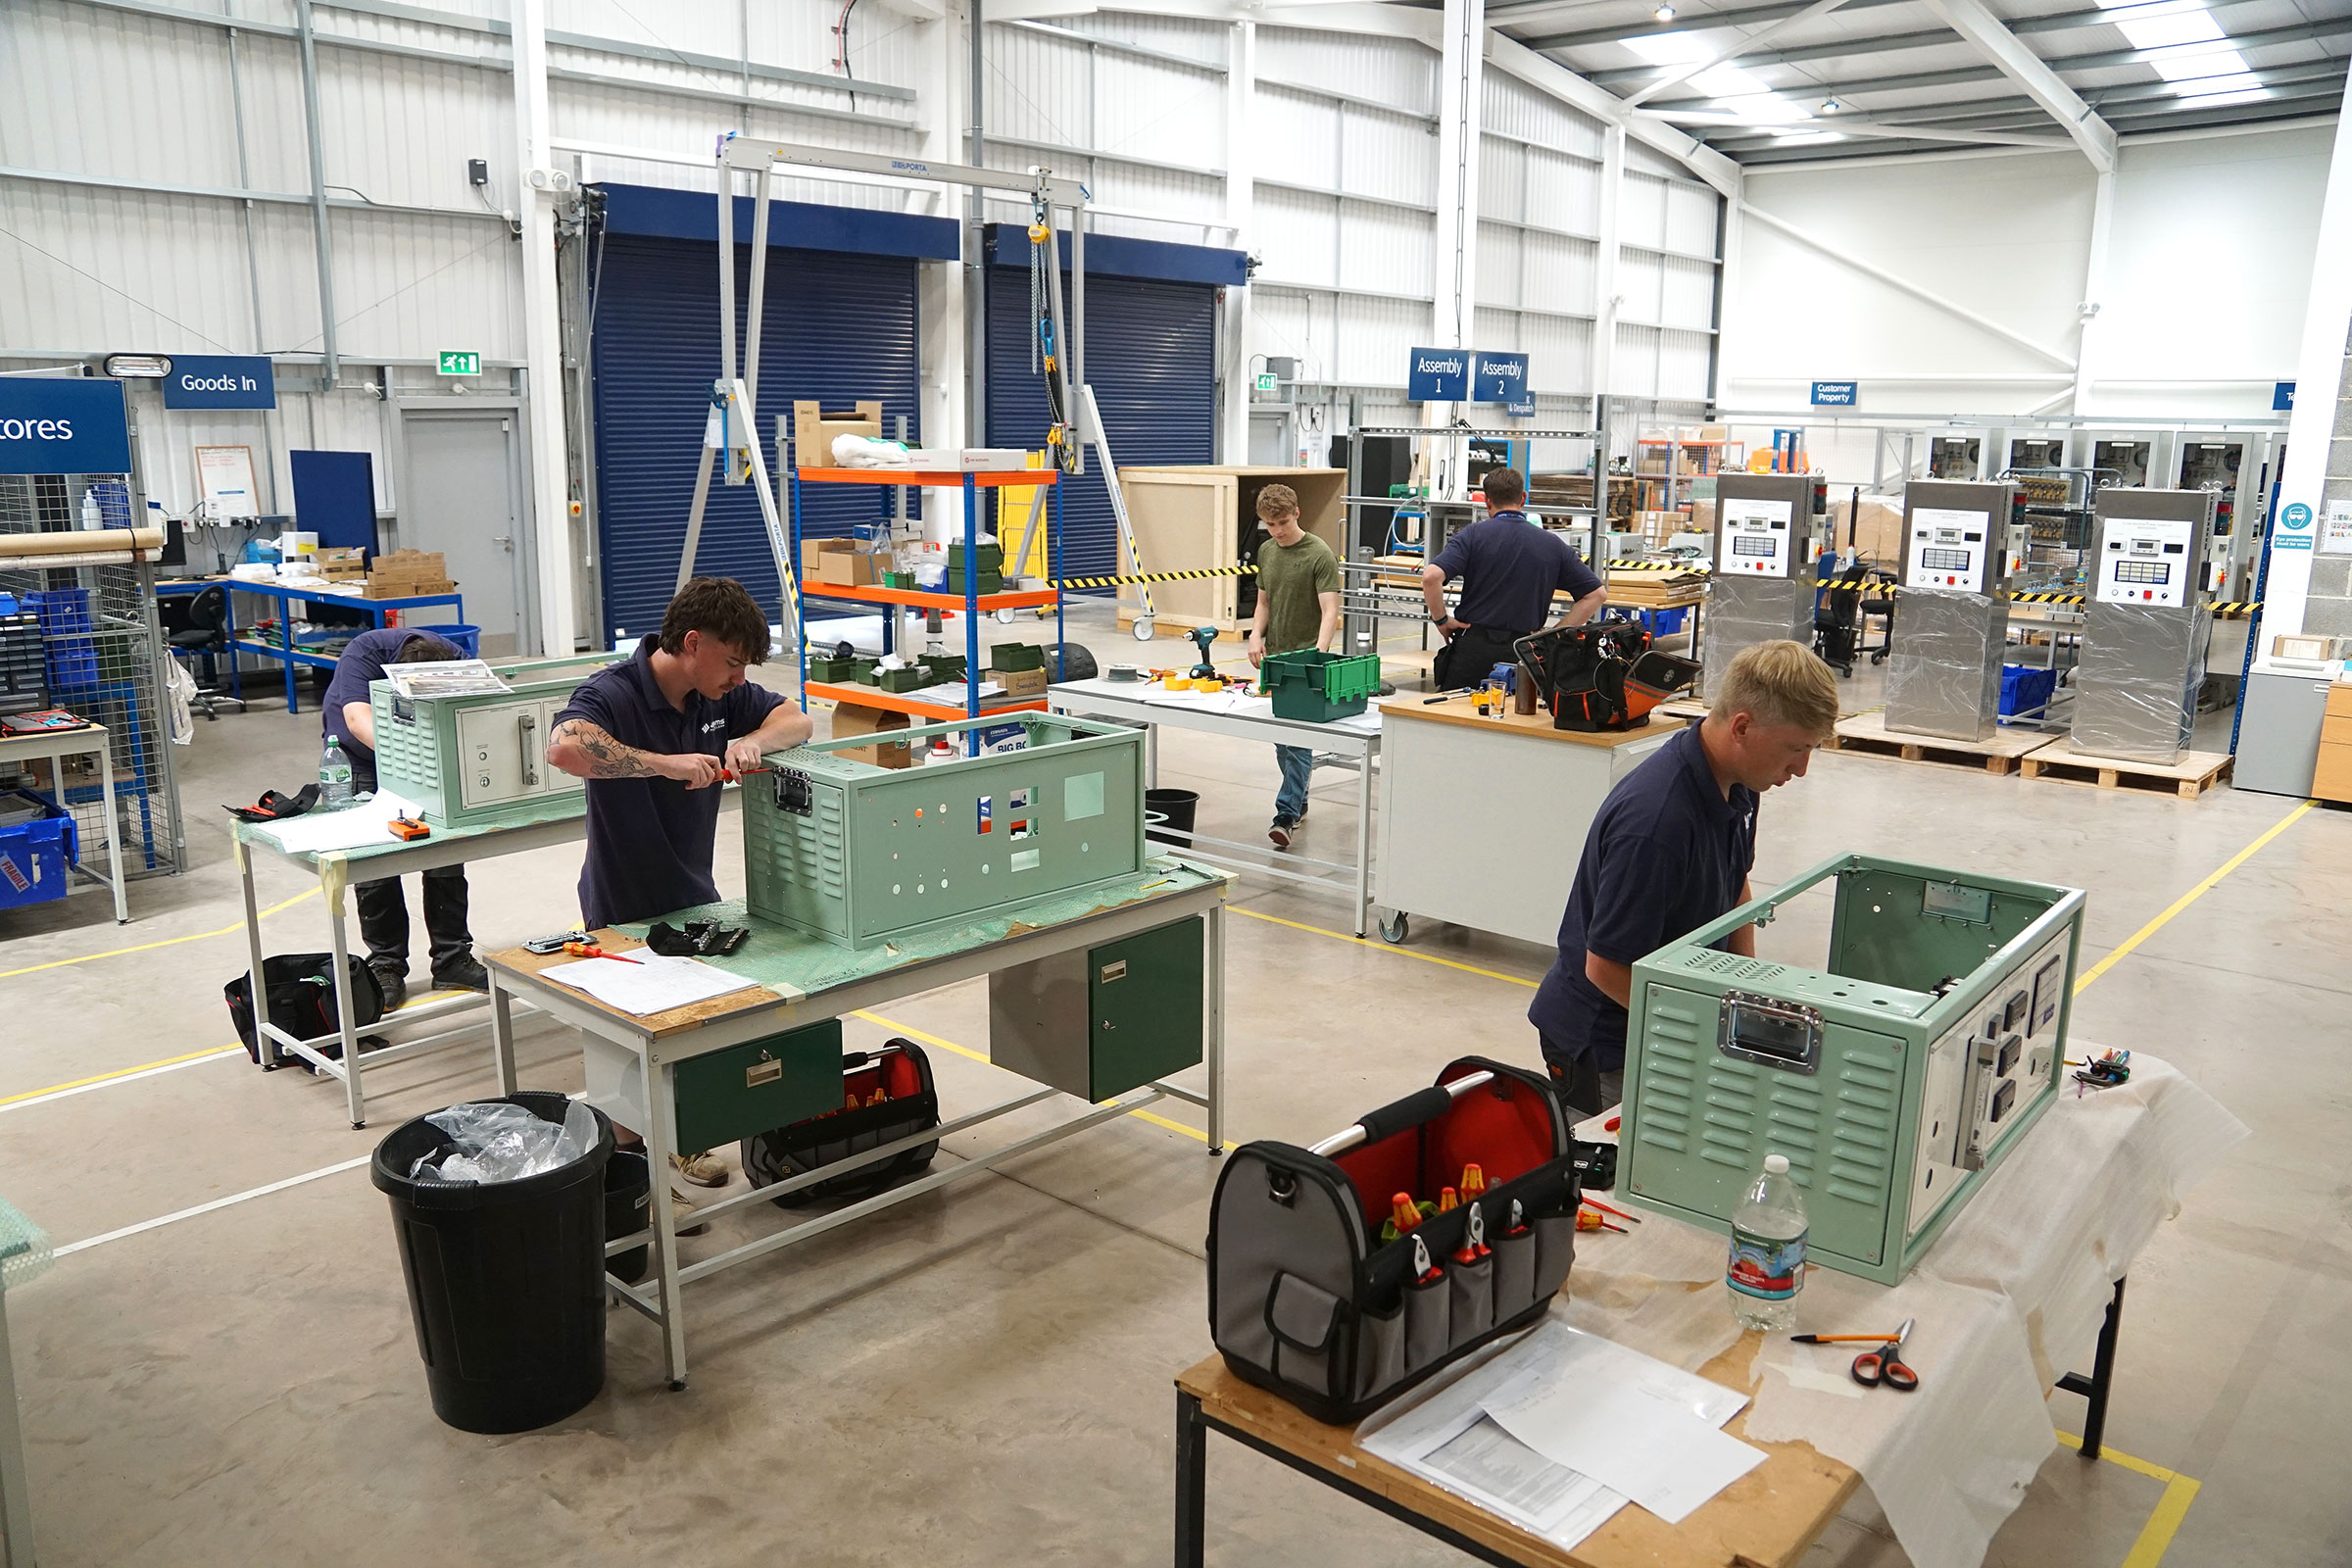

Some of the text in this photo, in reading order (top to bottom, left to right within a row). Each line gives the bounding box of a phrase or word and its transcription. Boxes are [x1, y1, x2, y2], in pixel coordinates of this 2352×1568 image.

[1417, 357, 1463, 378] Assembly
[1482, 360, 1523, 380] Assembly
[181, 373, 257, 391] Goods In
[1435, 378, 1442, 393] 1
[1497, 380, 1504, 395] 2
[1817, 384, 1851, 393] Customer
[1818, 393, 1850, 403] Property
[1508, 403, 1535, 415] & Despatch
[998, 743, 1013, 753] BIG
[1, 860, 28, 890] FRAGILE
